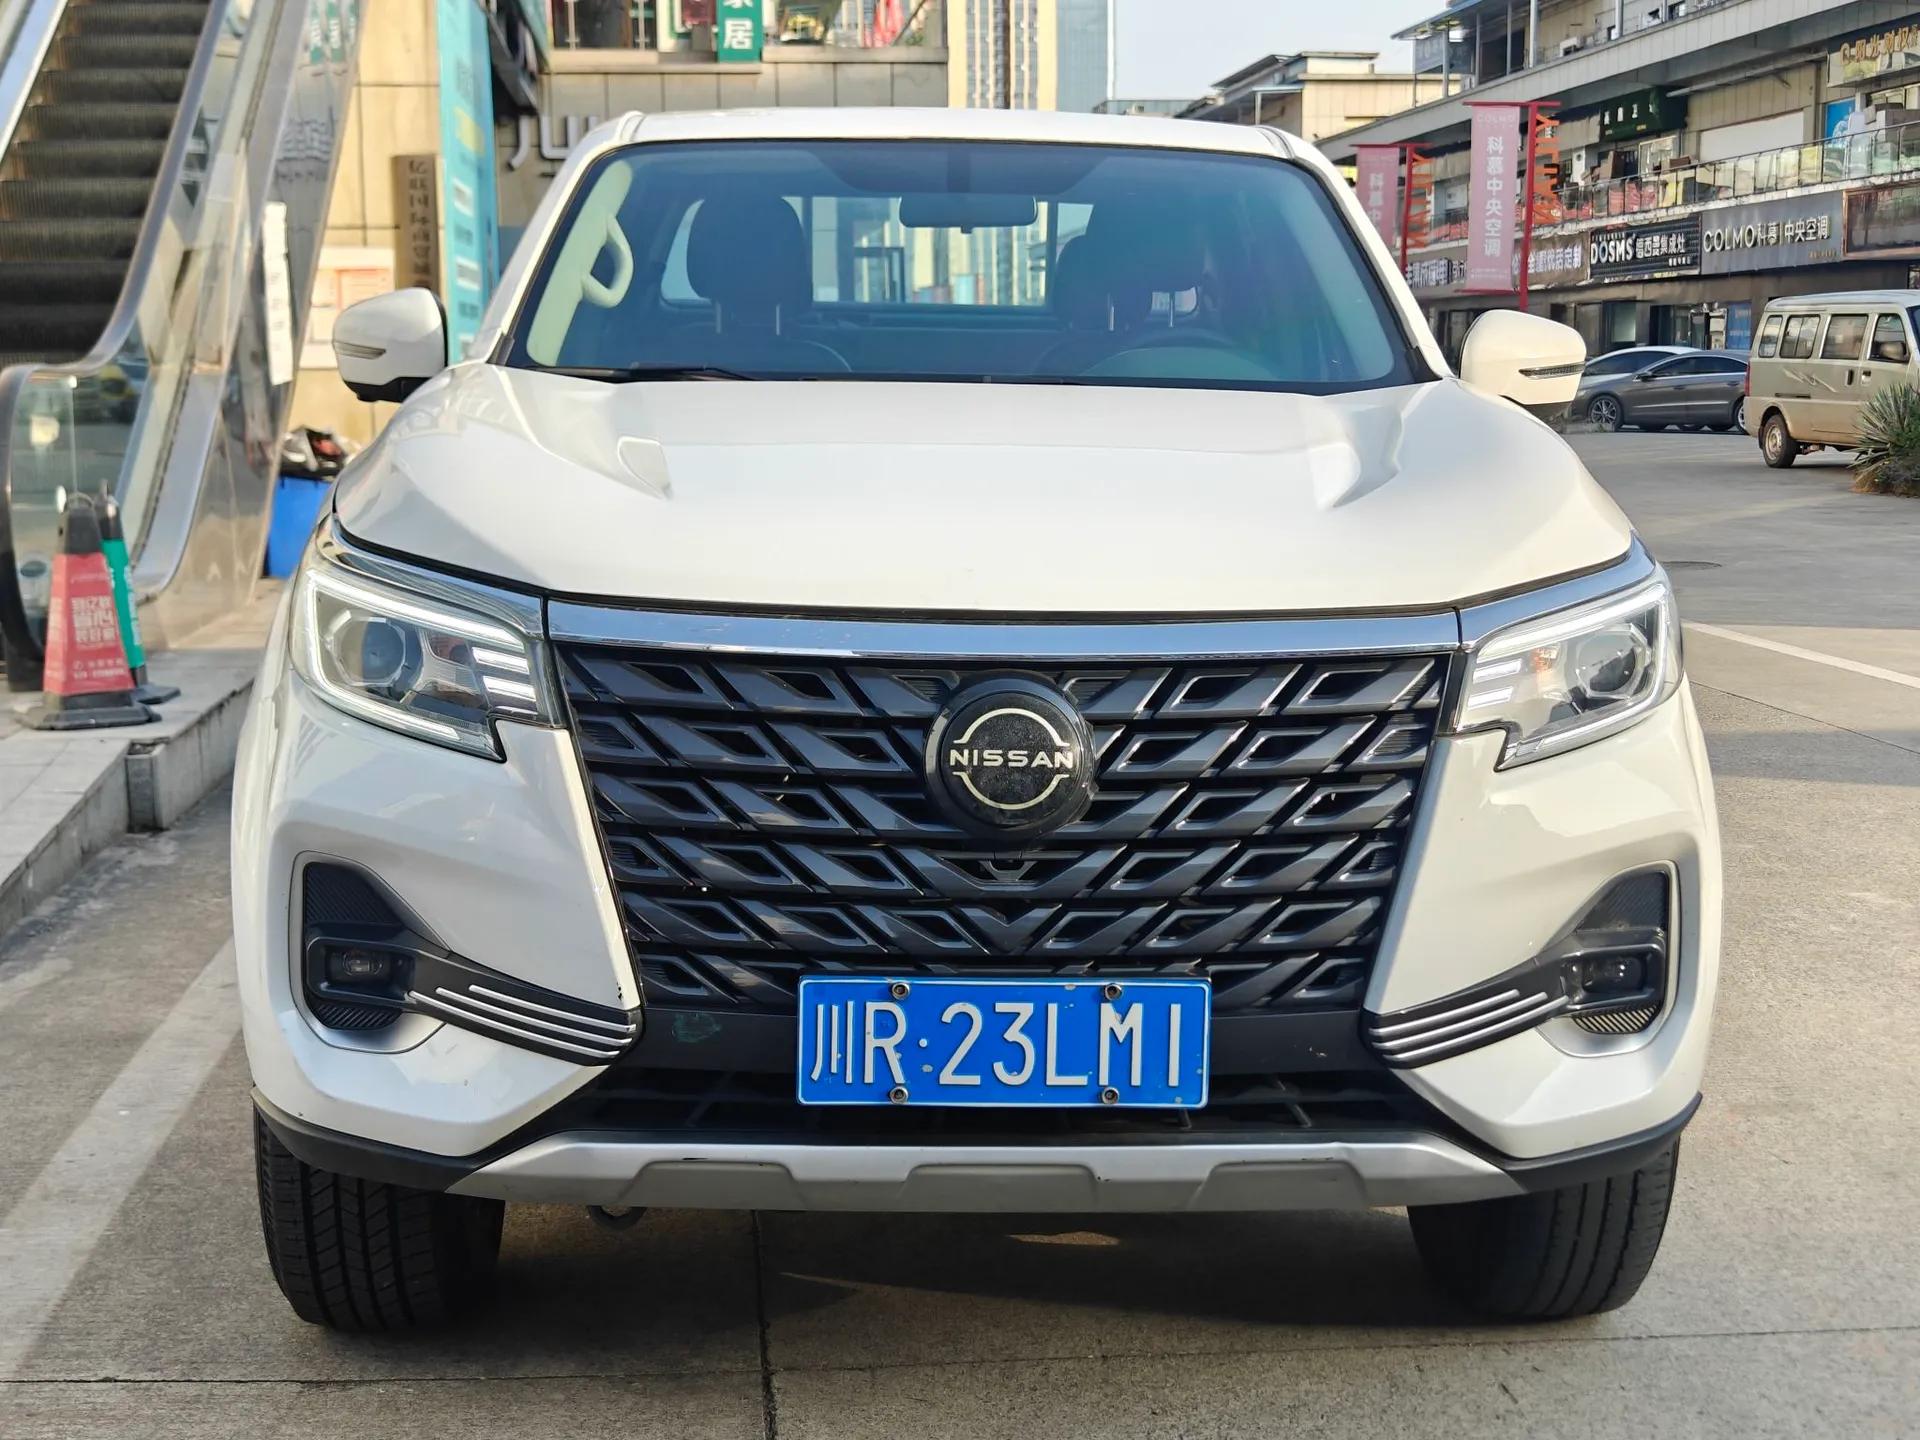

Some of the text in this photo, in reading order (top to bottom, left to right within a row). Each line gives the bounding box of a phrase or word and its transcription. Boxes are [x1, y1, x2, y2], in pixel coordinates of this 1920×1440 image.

[723, 0, 754, 49] 居
[1484, 136, 1504, 257] 科慕中央空调
[1591, 238, 1634, 264] DOSMS
[1703, 224, 1756, 253] COLMO
[1784, 215, 1829, 243] 中央空调
[950, 749, 1074, 768] NISSAN
